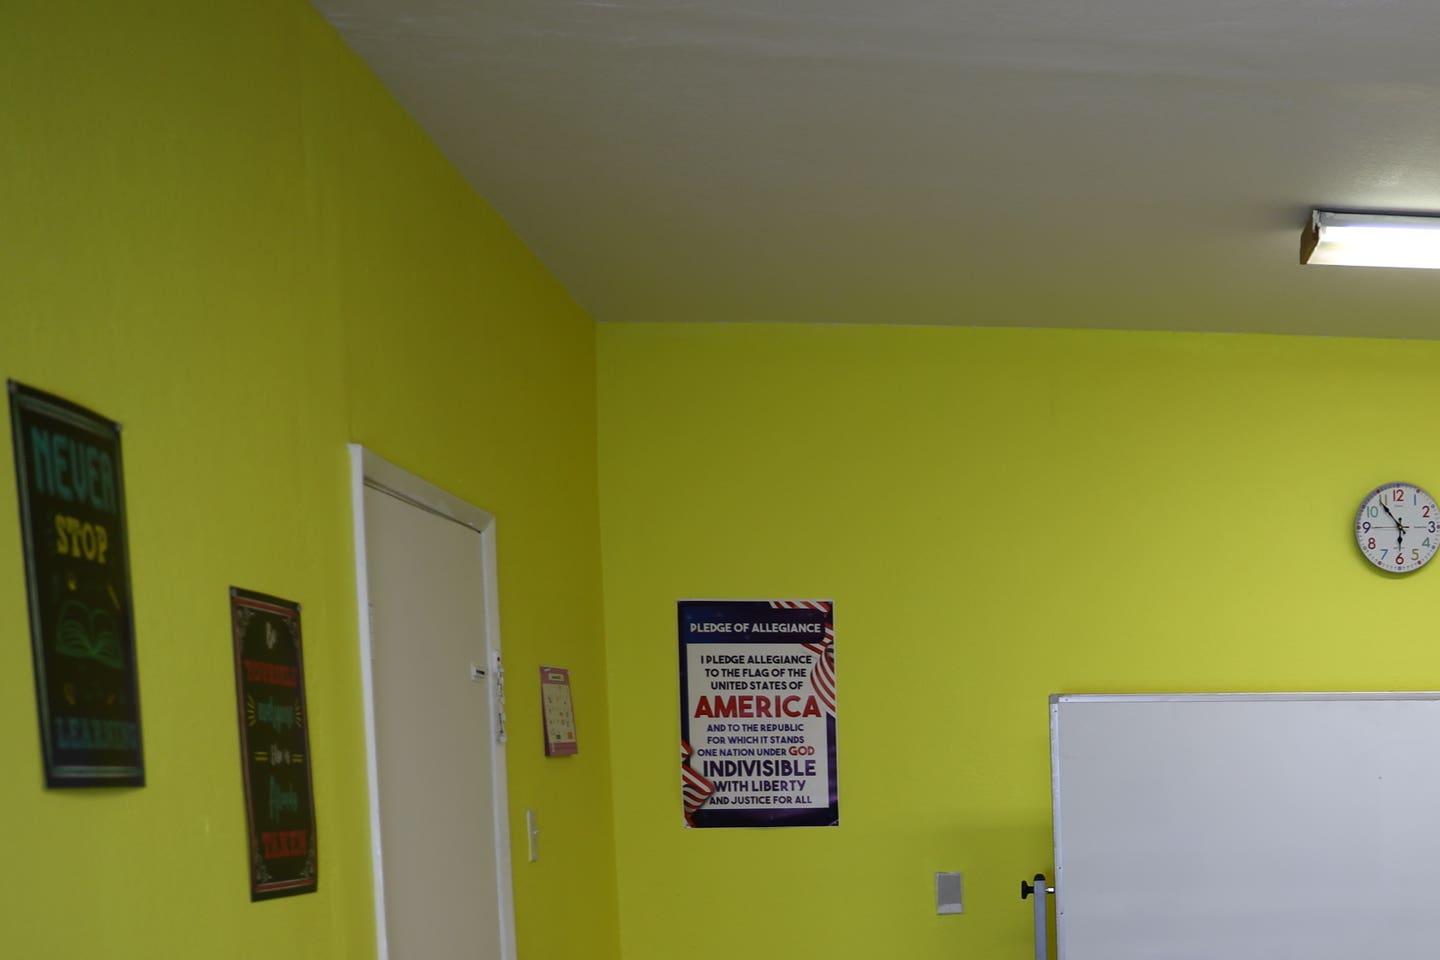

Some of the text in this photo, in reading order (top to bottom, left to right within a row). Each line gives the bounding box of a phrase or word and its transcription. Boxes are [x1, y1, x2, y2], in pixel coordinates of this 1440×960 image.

[29, 425, 116, 514] NEVER
[1393, 489, 1404, 502] 12
[1366, 506, 1379, 518] 10
[1422, 505, 1430, 518] 2
[1362, 521, 1371, 533] 9
[1427, 521, 1436, 533] 3
[53, 514, 110, 565] STOP
[1368, 537, 1376, 549] 8
[1422, 537, 1431, 548] 4
[1380, 549, 1388, 560] 7
[1395, 553, 1404, 565] 6
[1411, 548, 1419, 560] 5
[690, 623, 821, 633] PLEDGE OF ALLEGIANCE
[701, 655, 812, 664] I PLEDGE ALLEGIANCE
[705, 668, 807, 677] TO THE FLAG OF THE
[711, 681, 803, 690] UNITED STATES OF
[694, 694, 823, 718] AMERICA
[707, 723, 804, 732] AND TO THE REPUBLIC
[707, 736, 805, 744] FOR WHICH IT STANDS
[697, 746, 815, 757] ONE NATION UNDER GOD
[704, 759, 817, 777] INDIVISIBLE
[713, 780, 806, 792] WITH LIBERTY
[709, 795, 812, 805] AND JUSTICE FOR ALL
